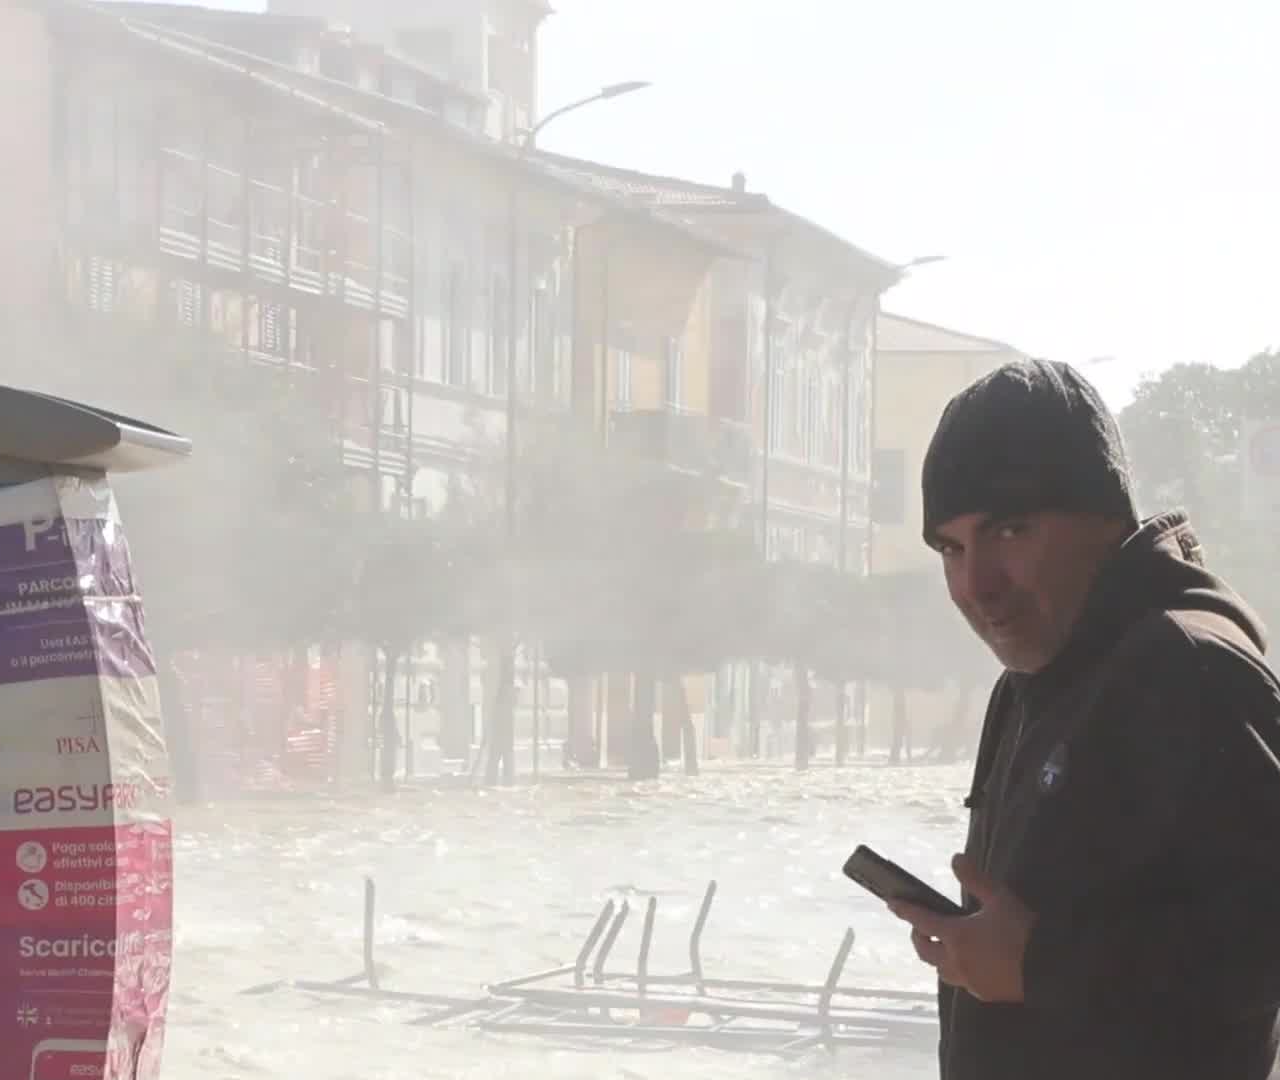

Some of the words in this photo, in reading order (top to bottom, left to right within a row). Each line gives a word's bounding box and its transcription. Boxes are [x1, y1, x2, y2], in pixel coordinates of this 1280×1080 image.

[56, 736, 100, 754] PISA
[13, 782, 138, 815] easyP
[52, 841, 85, 856] Paga
